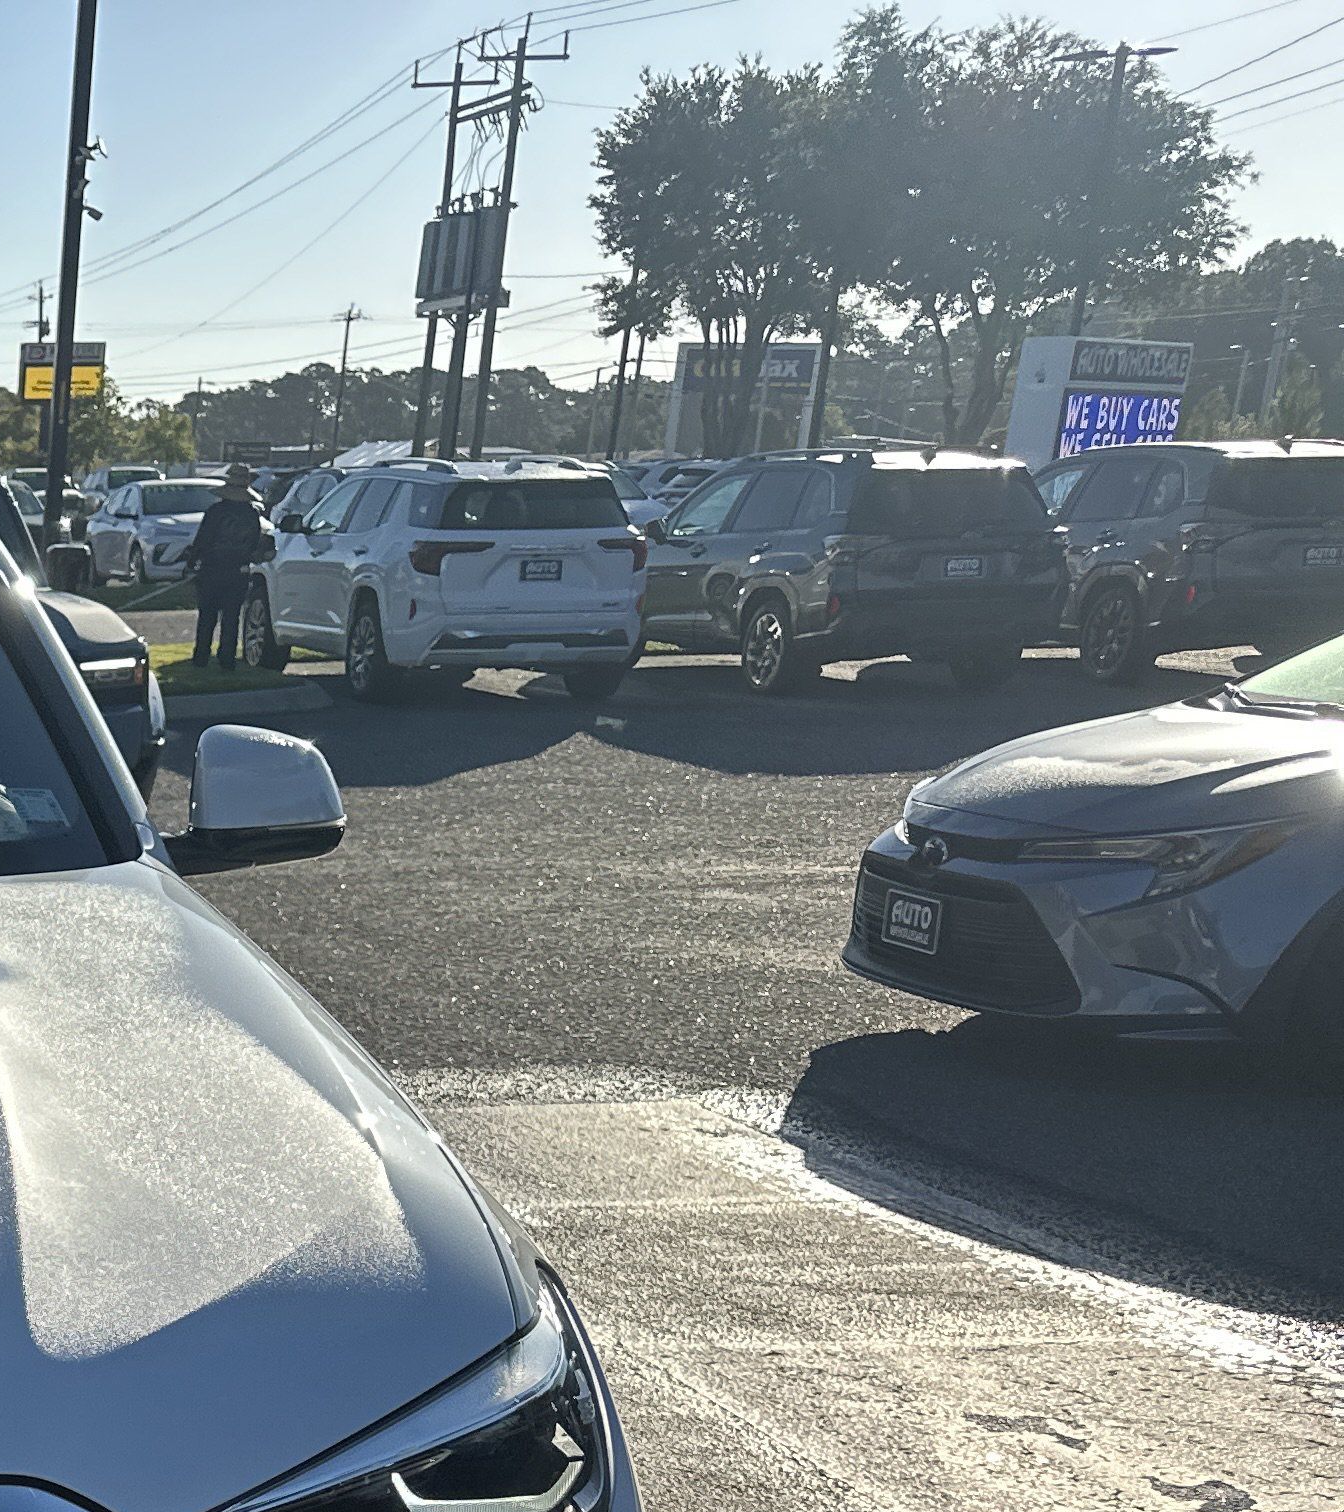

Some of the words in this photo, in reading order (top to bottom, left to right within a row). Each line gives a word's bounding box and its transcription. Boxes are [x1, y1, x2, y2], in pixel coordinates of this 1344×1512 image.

[1076, 347, 1113, 375] AUTO
[1065, 395, 1092, 429] WE
[1095, 396, 1134, 432] BUY
[1137, 398, 1181, 431] CARS
[891, 900, 932, 930] AUTO
